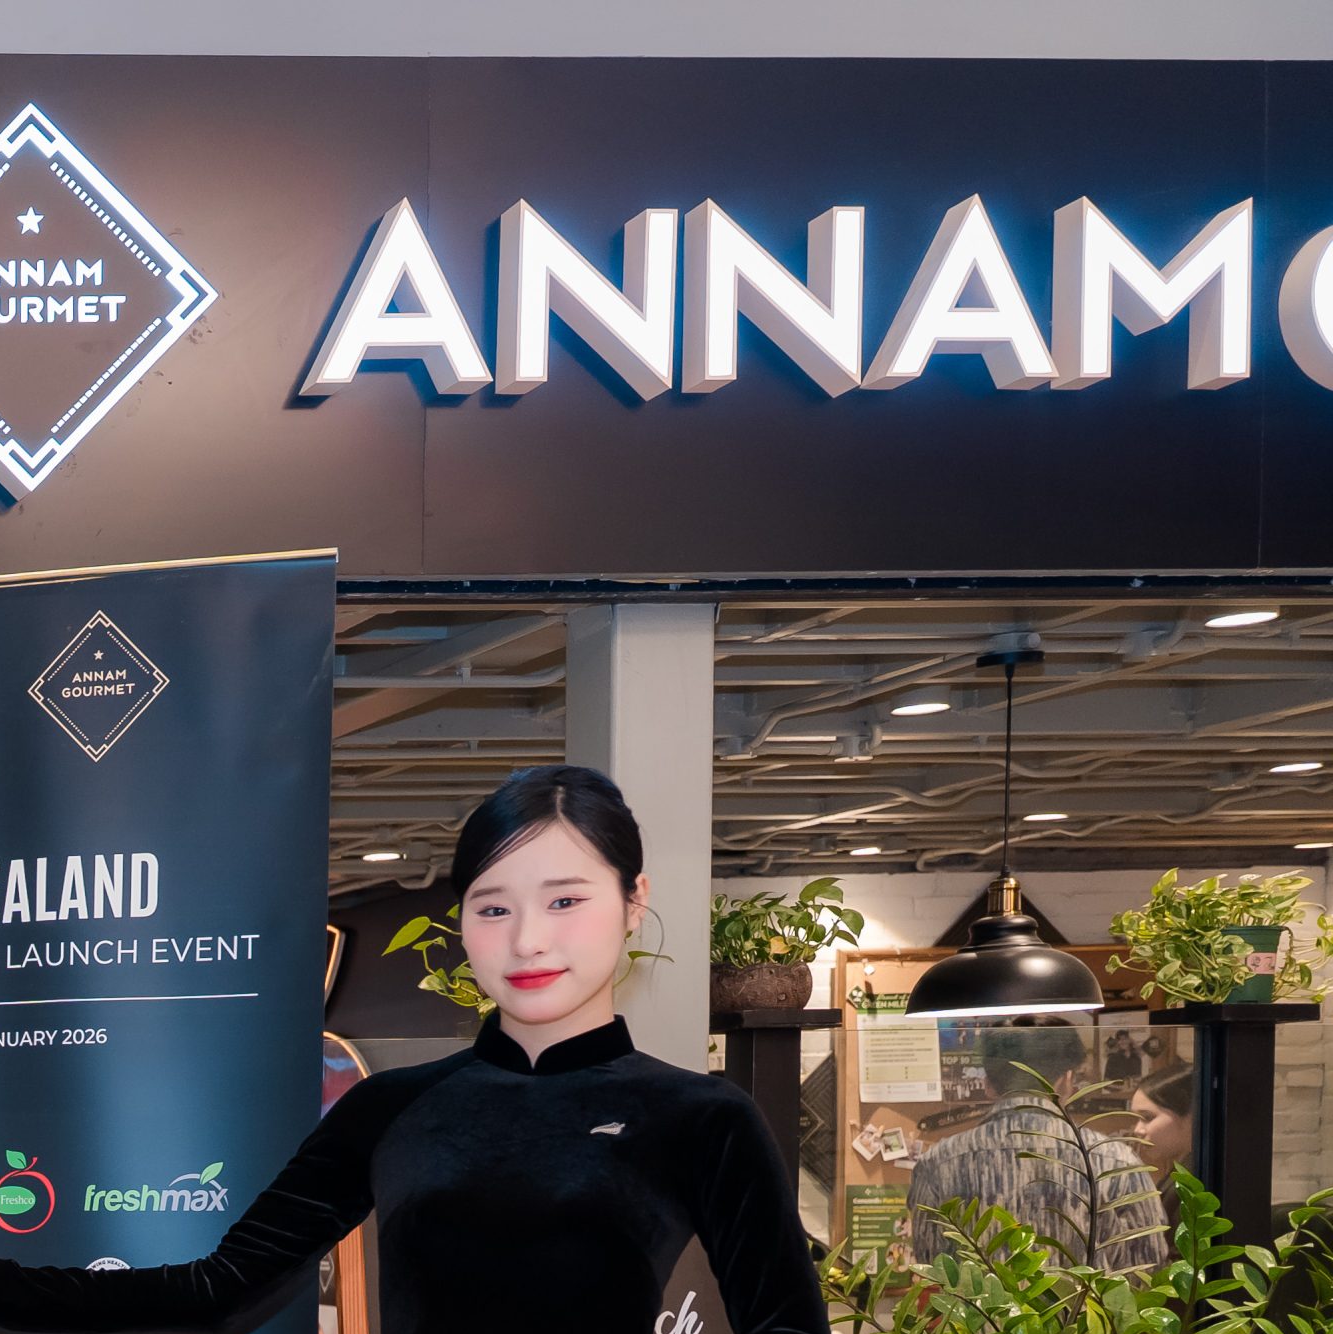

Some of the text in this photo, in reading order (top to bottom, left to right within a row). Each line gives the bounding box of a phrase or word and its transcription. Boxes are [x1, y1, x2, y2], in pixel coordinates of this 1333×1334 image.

[303, 195, 1253, 401] ANNAM
[72, 670, 127, 683] ANNAM
[62, 683, 135, 697] GOURMET
[7, 940, 137, 968] LAUNCH
[152, 935, 259, 963] EVENT
[62, 1029, 107, 1044] 2026
[1, 1194, 35, 1206] Freshco
[84, 1184, 228, 1211] freshmax
